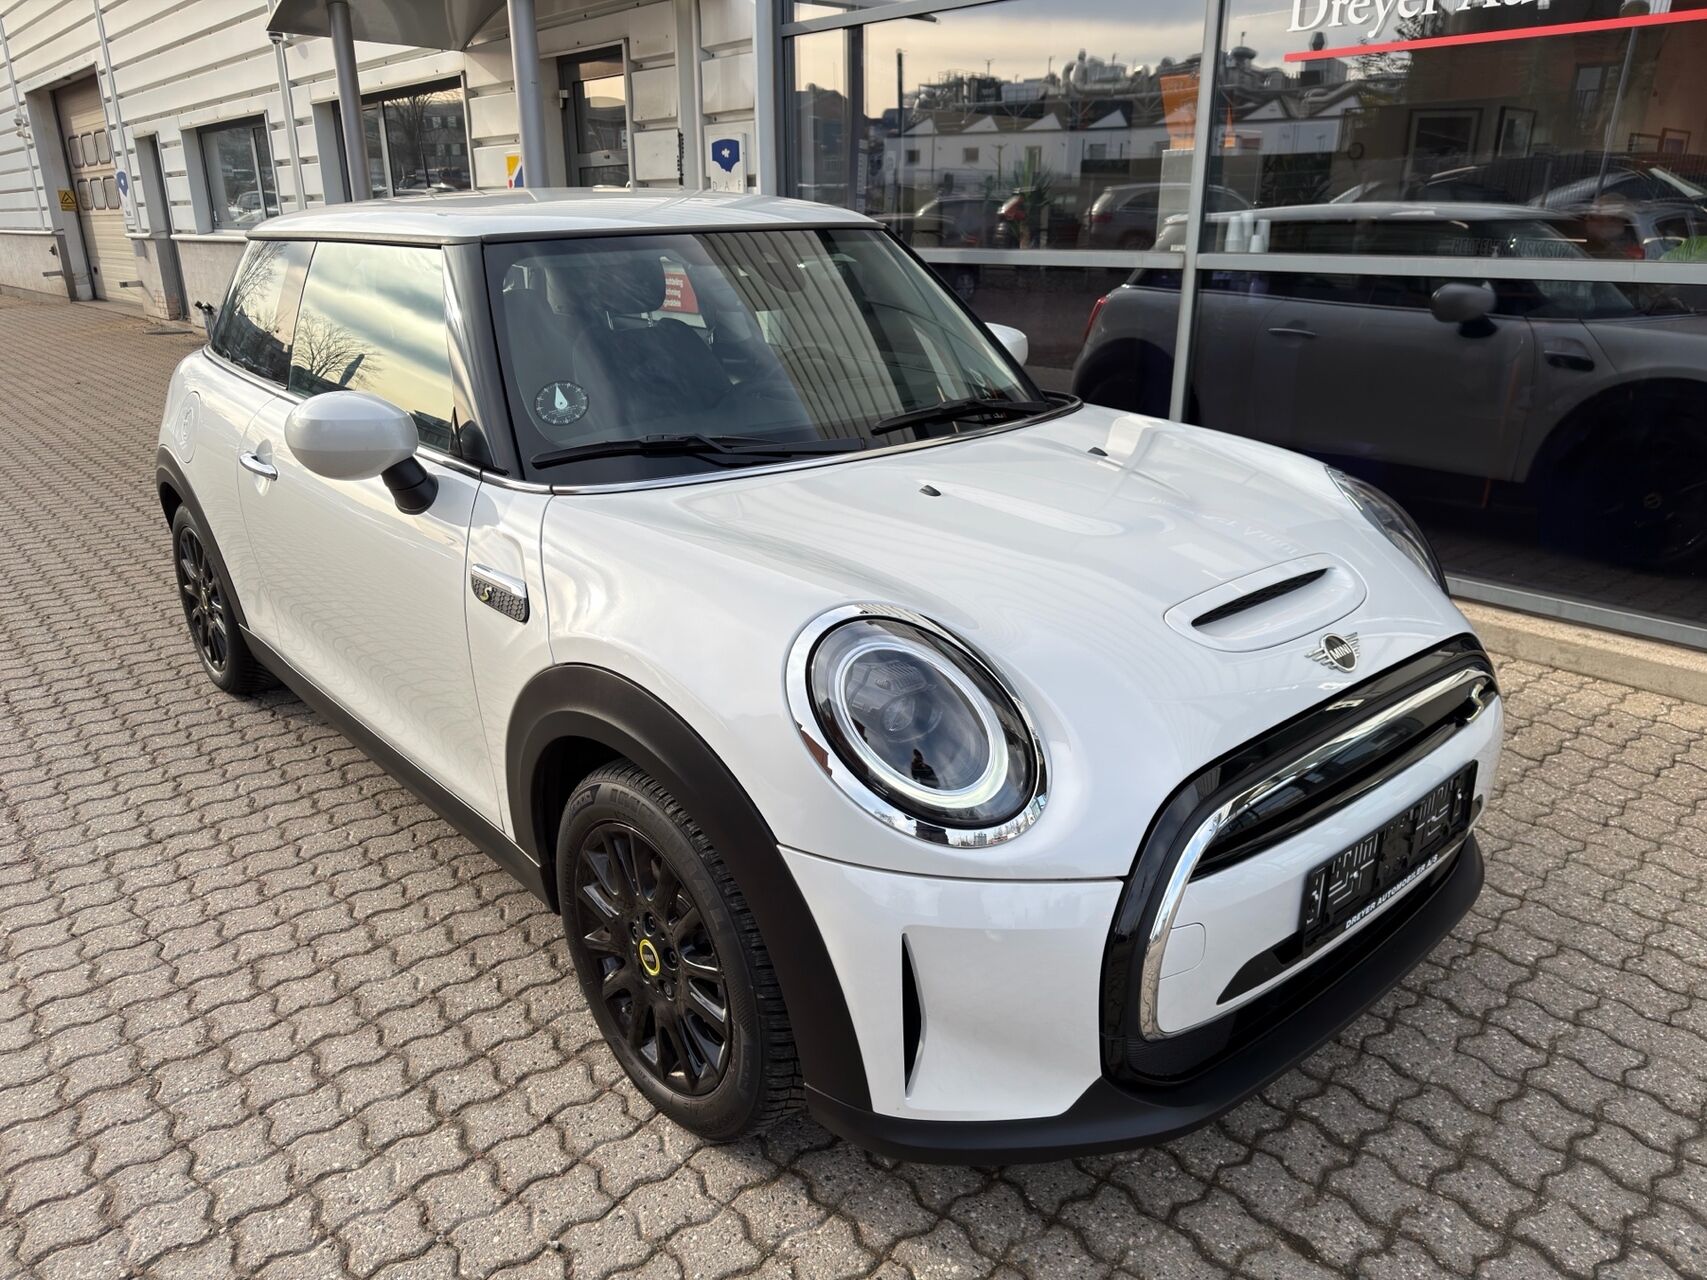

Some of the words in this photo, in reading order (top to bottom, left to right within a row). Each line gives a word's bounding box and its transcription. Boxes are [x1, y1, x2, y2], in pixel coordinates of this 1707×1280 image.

[1329, 643, 1352, 660] MINI
[1345, 901, 1376, 929] DREYER
[1377, 863, 1426, 906] AUTOMOBILER
